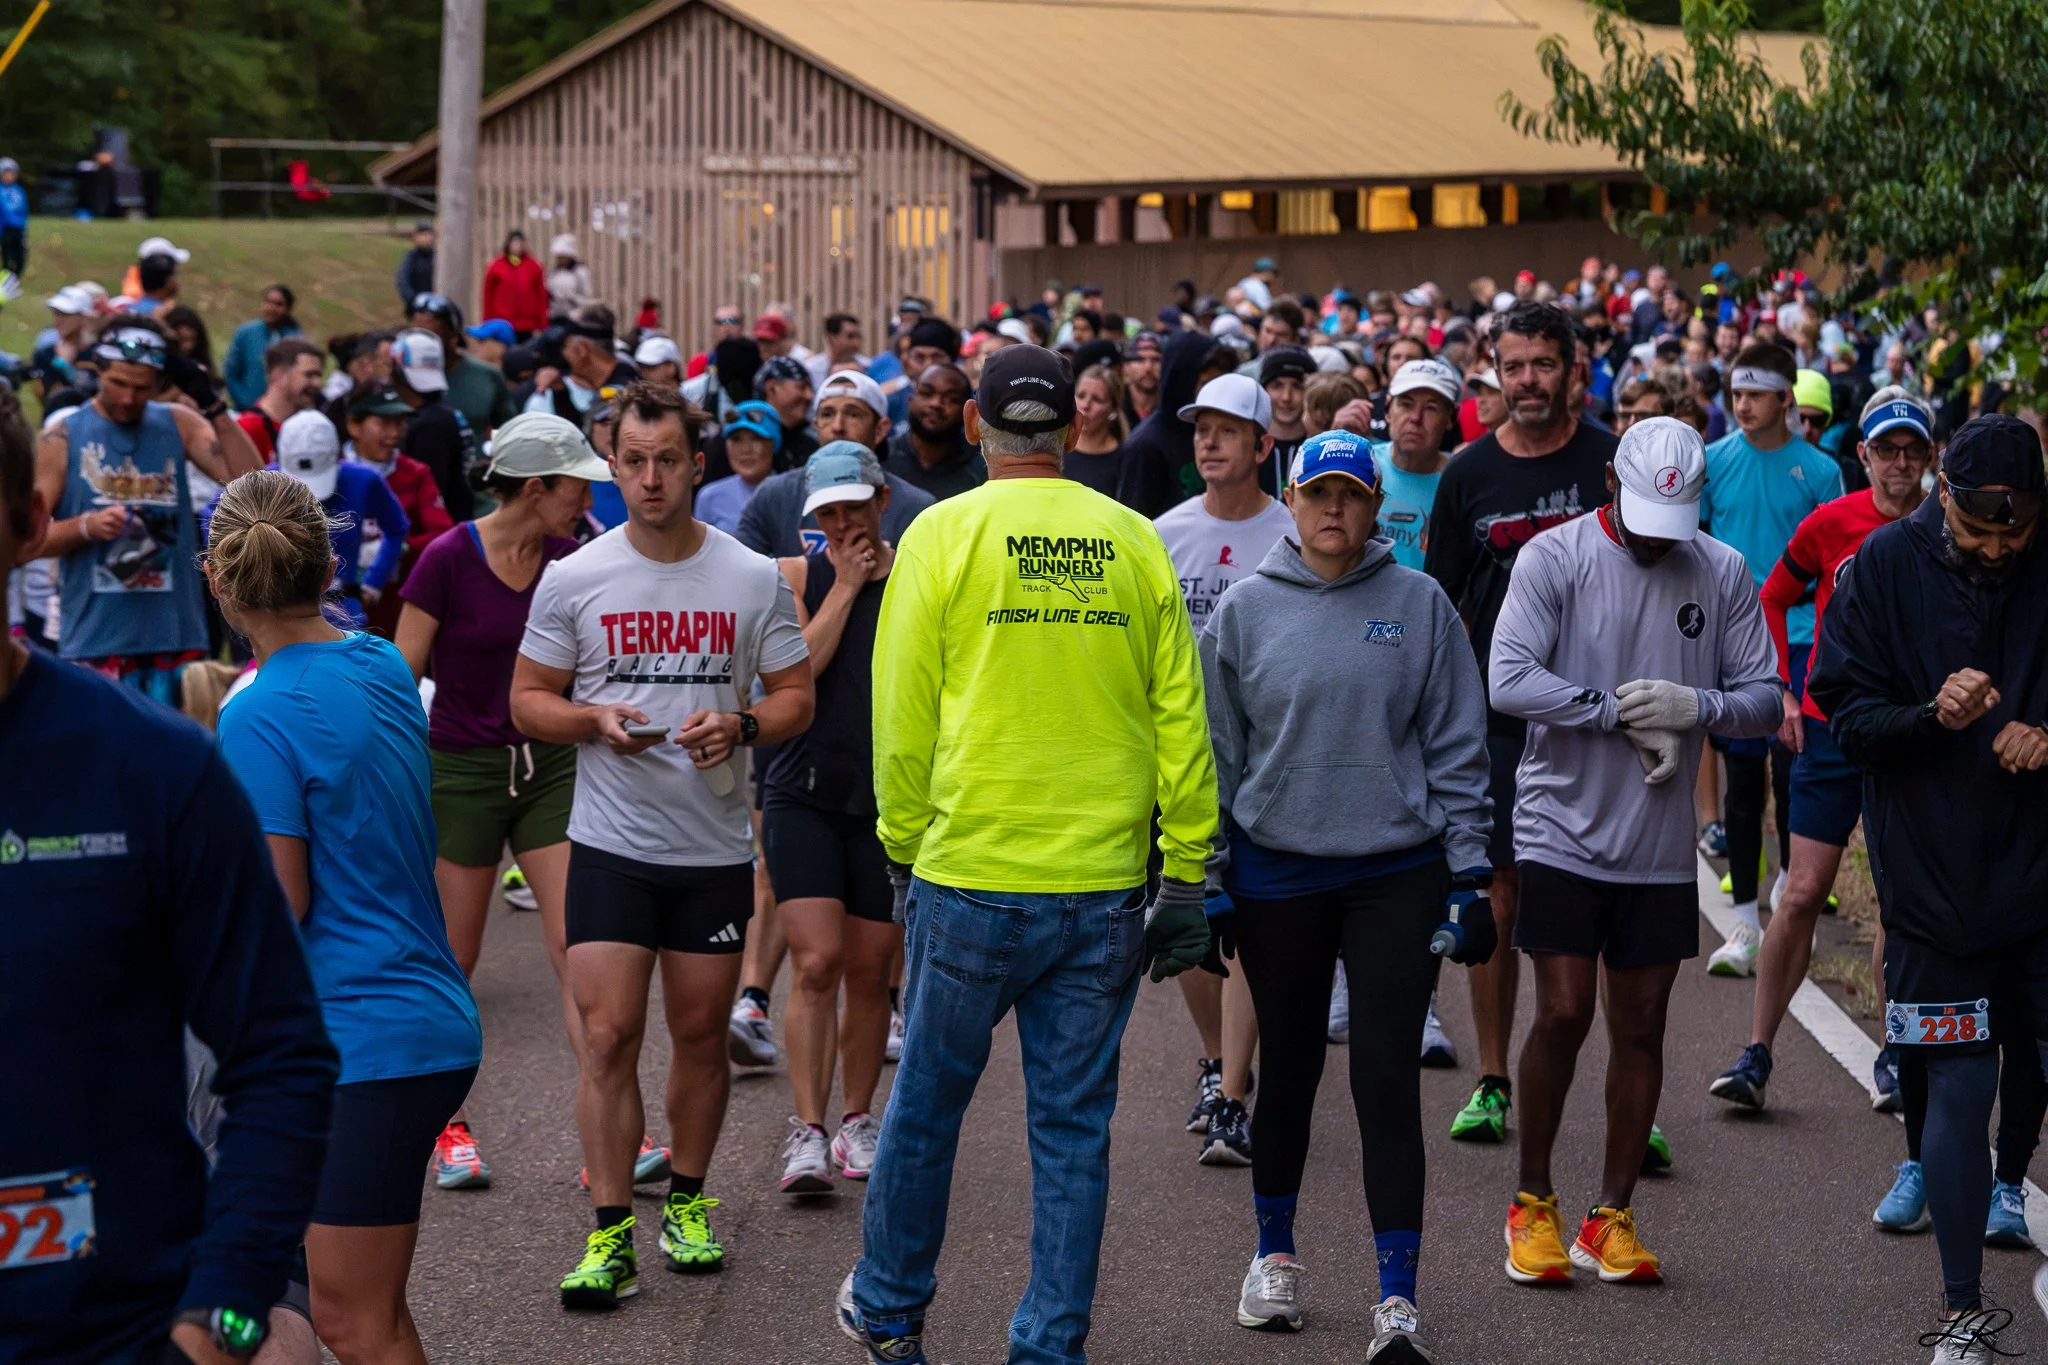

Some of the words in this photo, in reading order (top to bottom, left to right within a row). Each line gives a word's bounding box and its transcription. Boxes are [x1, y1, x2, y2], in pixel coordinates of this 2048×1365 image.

[1010, 377, 1026, 386] FINISH
[1040, 379, 1055, 389] CREW
[1006, 535, 1116, 562] MEMPHIS
[1018, 557, 1104, 576] RUNNERS
[1021, 584, 1052, 593] TRACK
[1083, 586, 1108, 595] CLUB
[1178, 577, 1205, 595] ST.
[986, 608, 1040, 626] FINISH
[1042, 608, 1081, 624] LINE
[1083, 610, 1131, 628] CREW
[601, 611, 736, 656] TERRAPIN
[608, 656, 732, 673] RACING
[1920, 1015, 1976, 1042] 228
